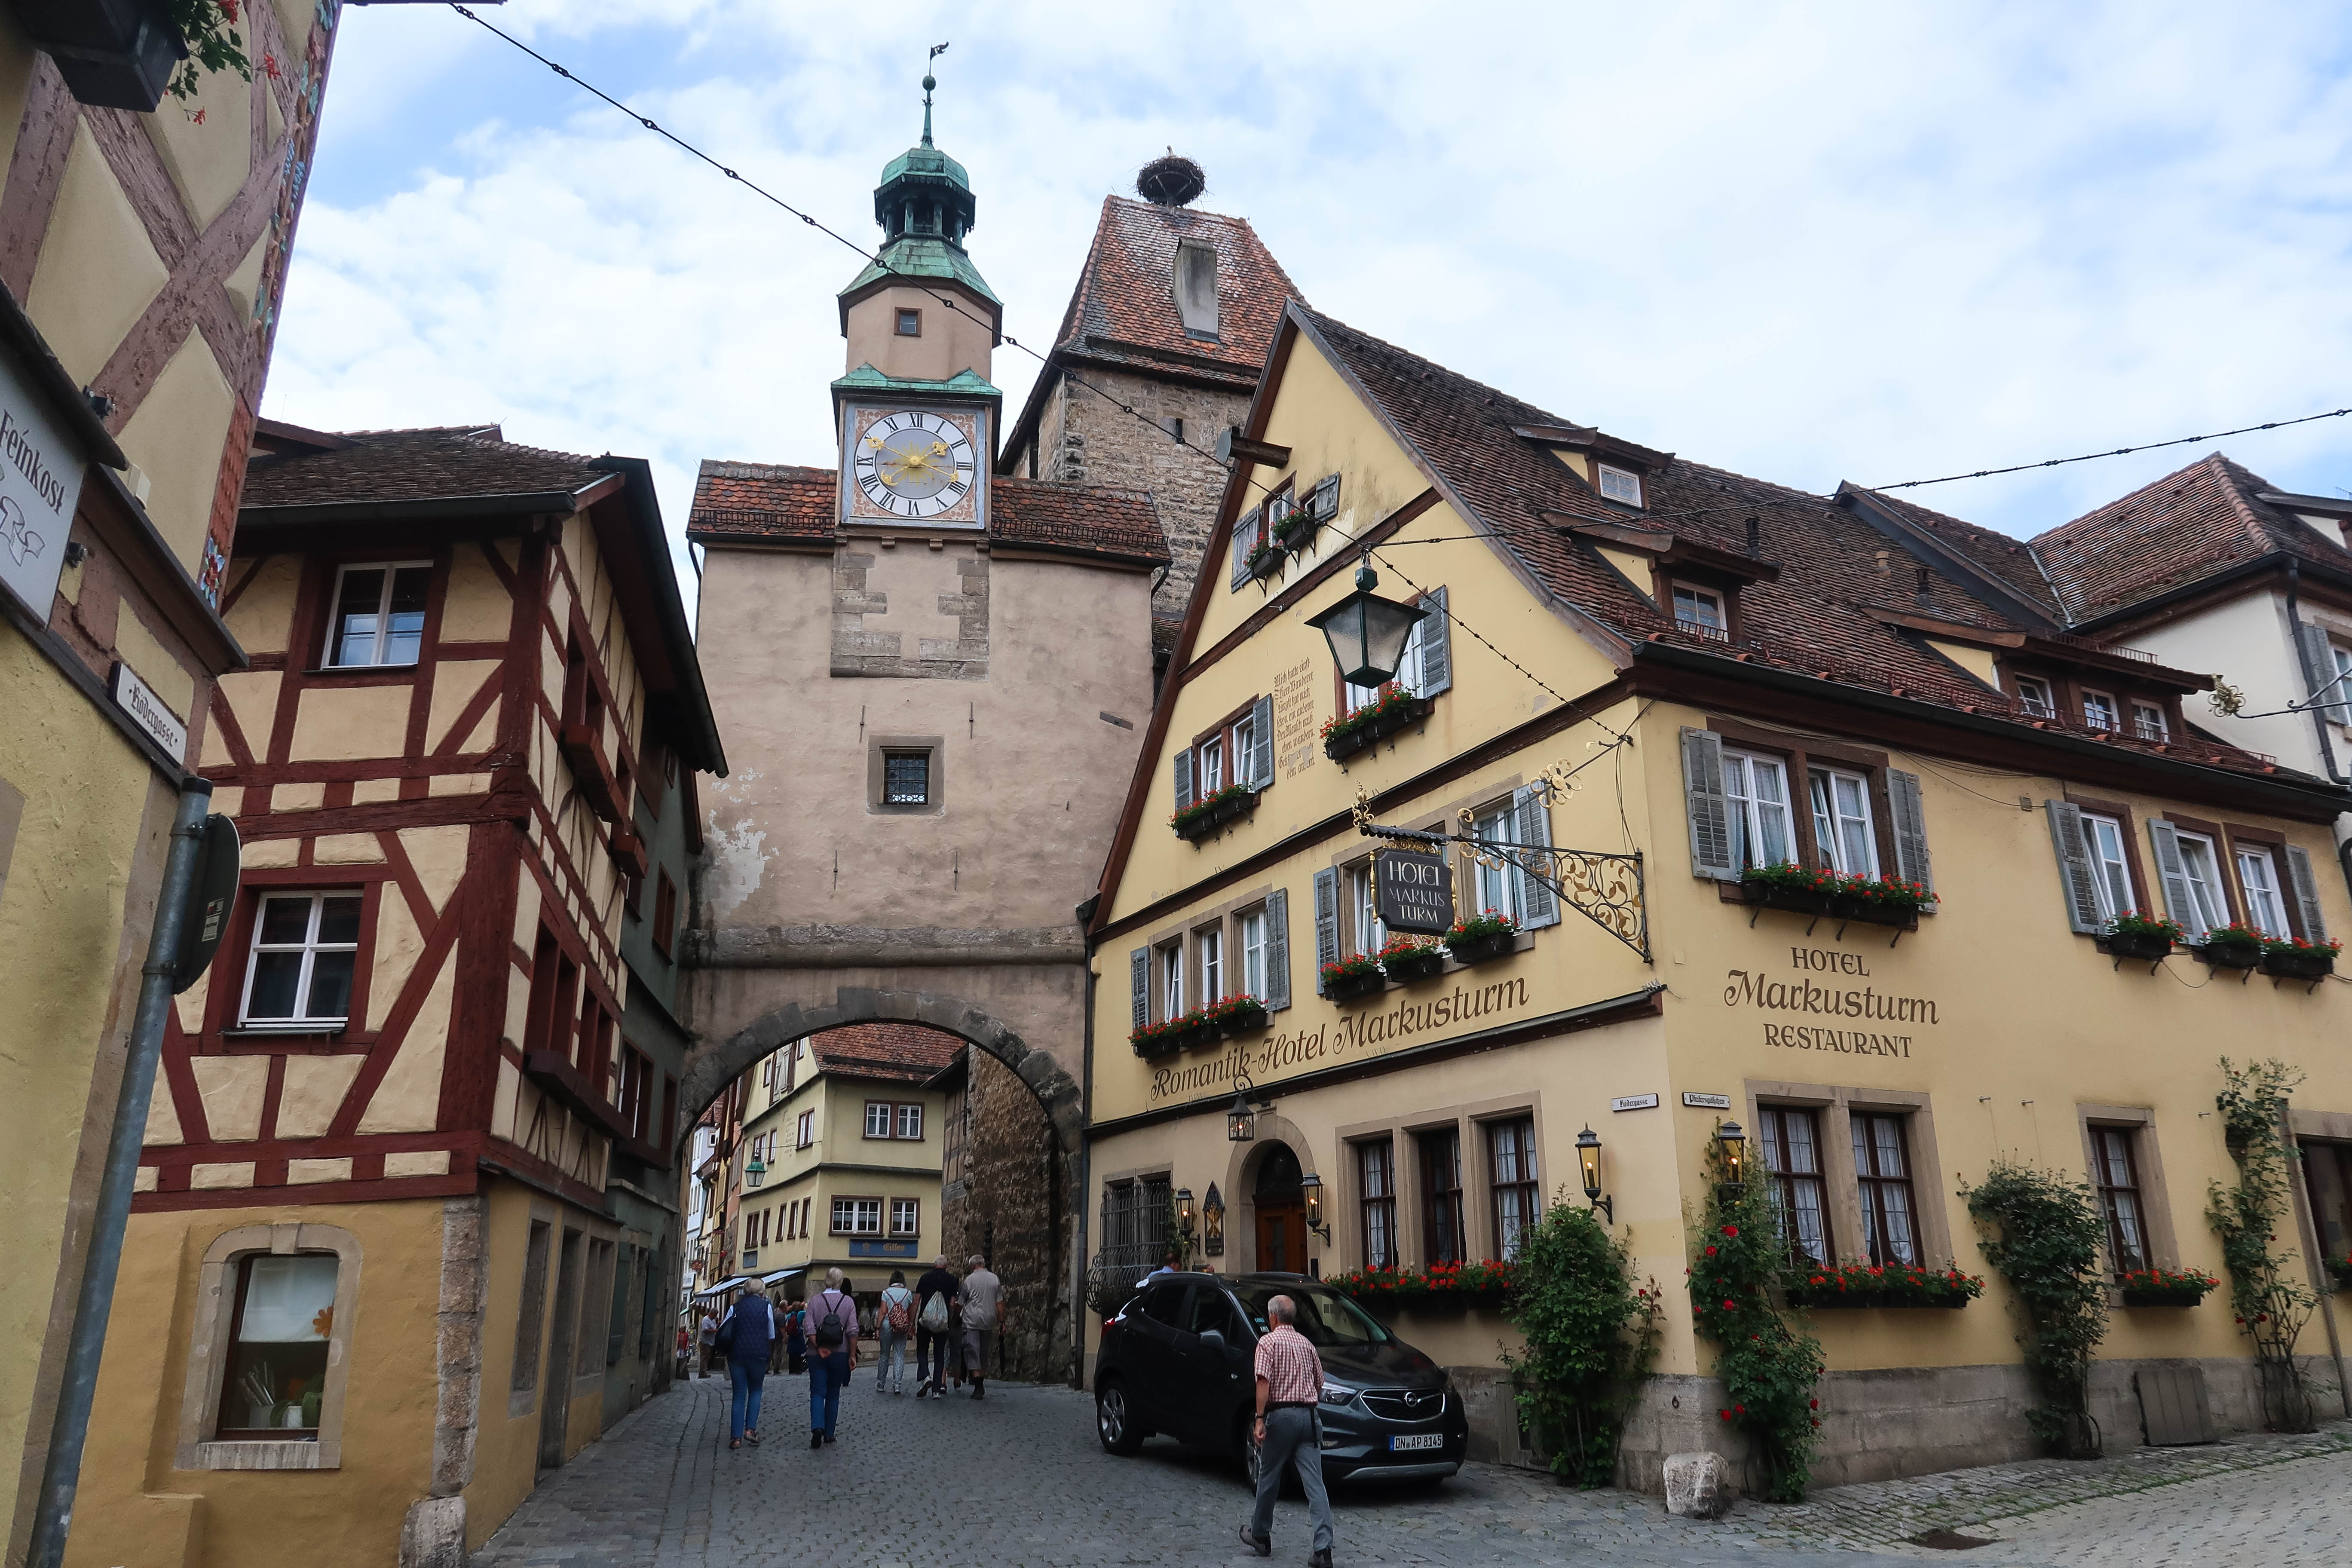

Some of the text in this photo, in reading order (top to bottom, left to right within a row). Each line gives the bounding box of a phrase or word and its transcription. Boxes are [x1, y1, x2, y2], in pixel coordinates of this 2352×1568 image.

[882, 416, 900, 433] XI
[909, 413, 924, 428] XII
[950, 438, 967, 450] II
[857, 455, 873, 467] IX
[956, 461, 972, 472] III
[860, 473, 881, 495] VIII
[878, 491, 896, 511] VII
[907, 500, 921, 515] VI
[935, 496, 949, 511] V
[1274, 657, 1310, 687] Mich hatte einst
[1290, 671, 1314, 692] Wanderer
[1300, 686, 1310, 701] mich
[132, 683, 174, 747] Rödergasse
[1277, 715, 1288, 729] schon
[1282, 741, 1292, 753] eben
[1389, 861, 1442, 886] HOTEL
[1389, 887, 1445, 907] MARKUS
[1398, 904, 1438, 923] TURM
[1790, 947, 1870, 977] HOTEL
[1724, 969, 1940, 1025] Markusturm
[1150, 977, 1530, 1101] Romantik-Hotel Markusturm
[1763, 1023, 1912, 1057] RESTAURANT
[1396, 1435, 1442, 1449] DN AP 8145
